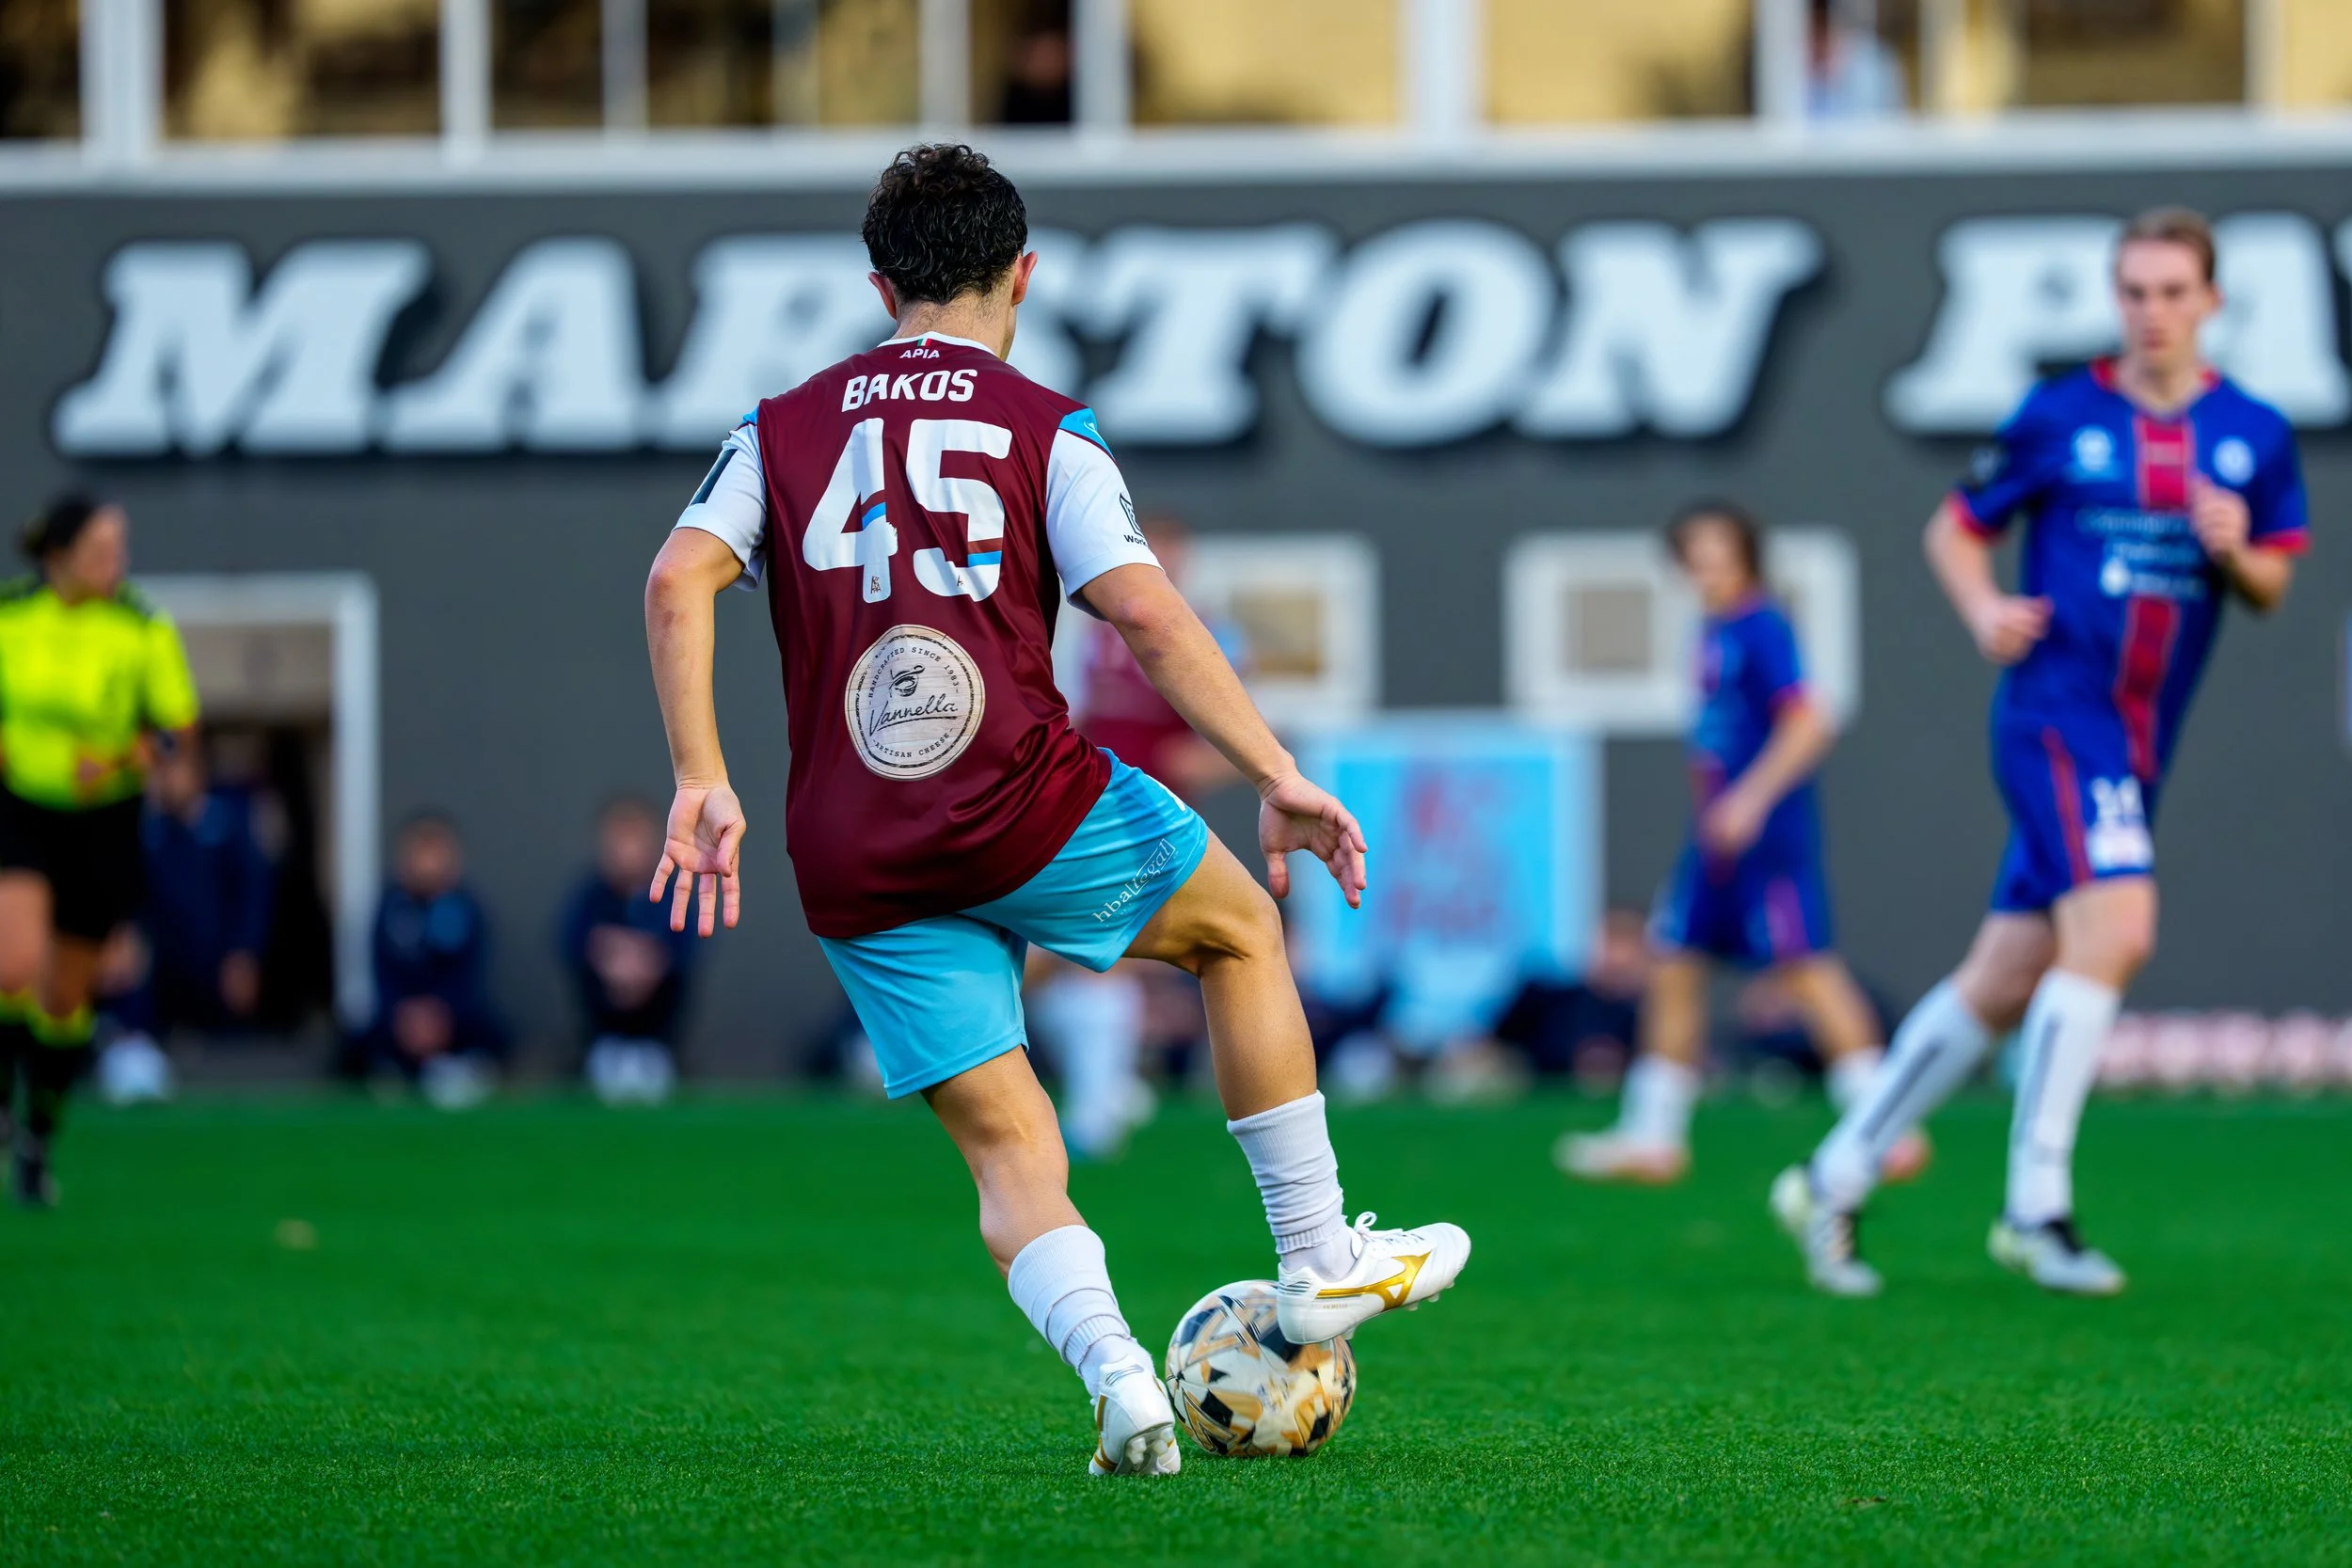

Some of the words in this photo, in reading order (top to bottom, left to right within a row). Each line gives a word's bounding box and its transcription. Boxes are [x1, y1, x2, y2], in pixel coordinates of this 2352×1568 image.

[898, 348, 941, 359] APIA
[841, 369, 978, 412] BAKOS
[803, 417, 1012, 604] 45
[868, 647, 905, 698] HANDCRAFTED
[911, 646, 942, 662] SINCE
[869, 693, 959, 737] Vannella
[875, 742, 913, 758] ARTISAN
[918, 732, 950, 756] CHEESE
